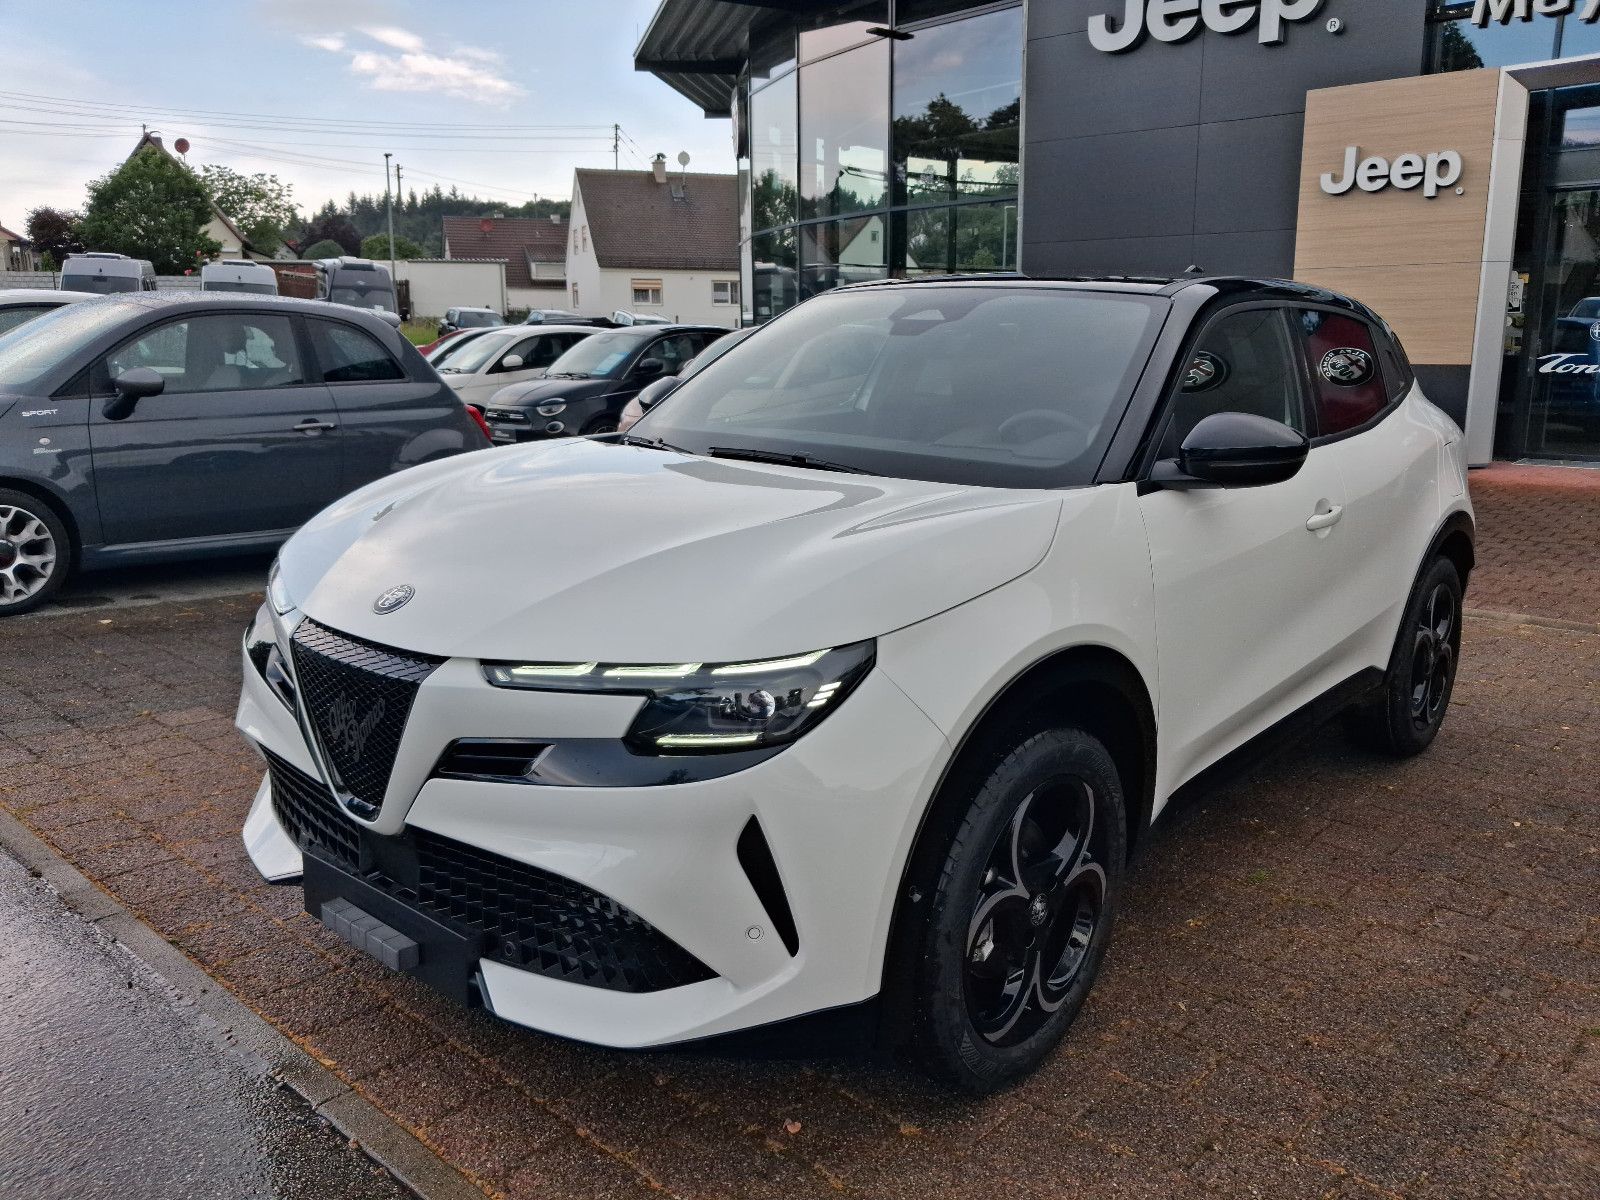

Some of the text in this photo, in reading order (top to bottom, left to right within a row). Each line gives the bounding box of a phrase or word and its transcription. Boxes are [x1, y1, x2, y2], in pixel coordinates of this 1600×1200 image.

[1088, 0, 1322, 51] Jeep
[1320, 146, 1462, 197] Jeep
[22, 408, 58, 417] SPORT
